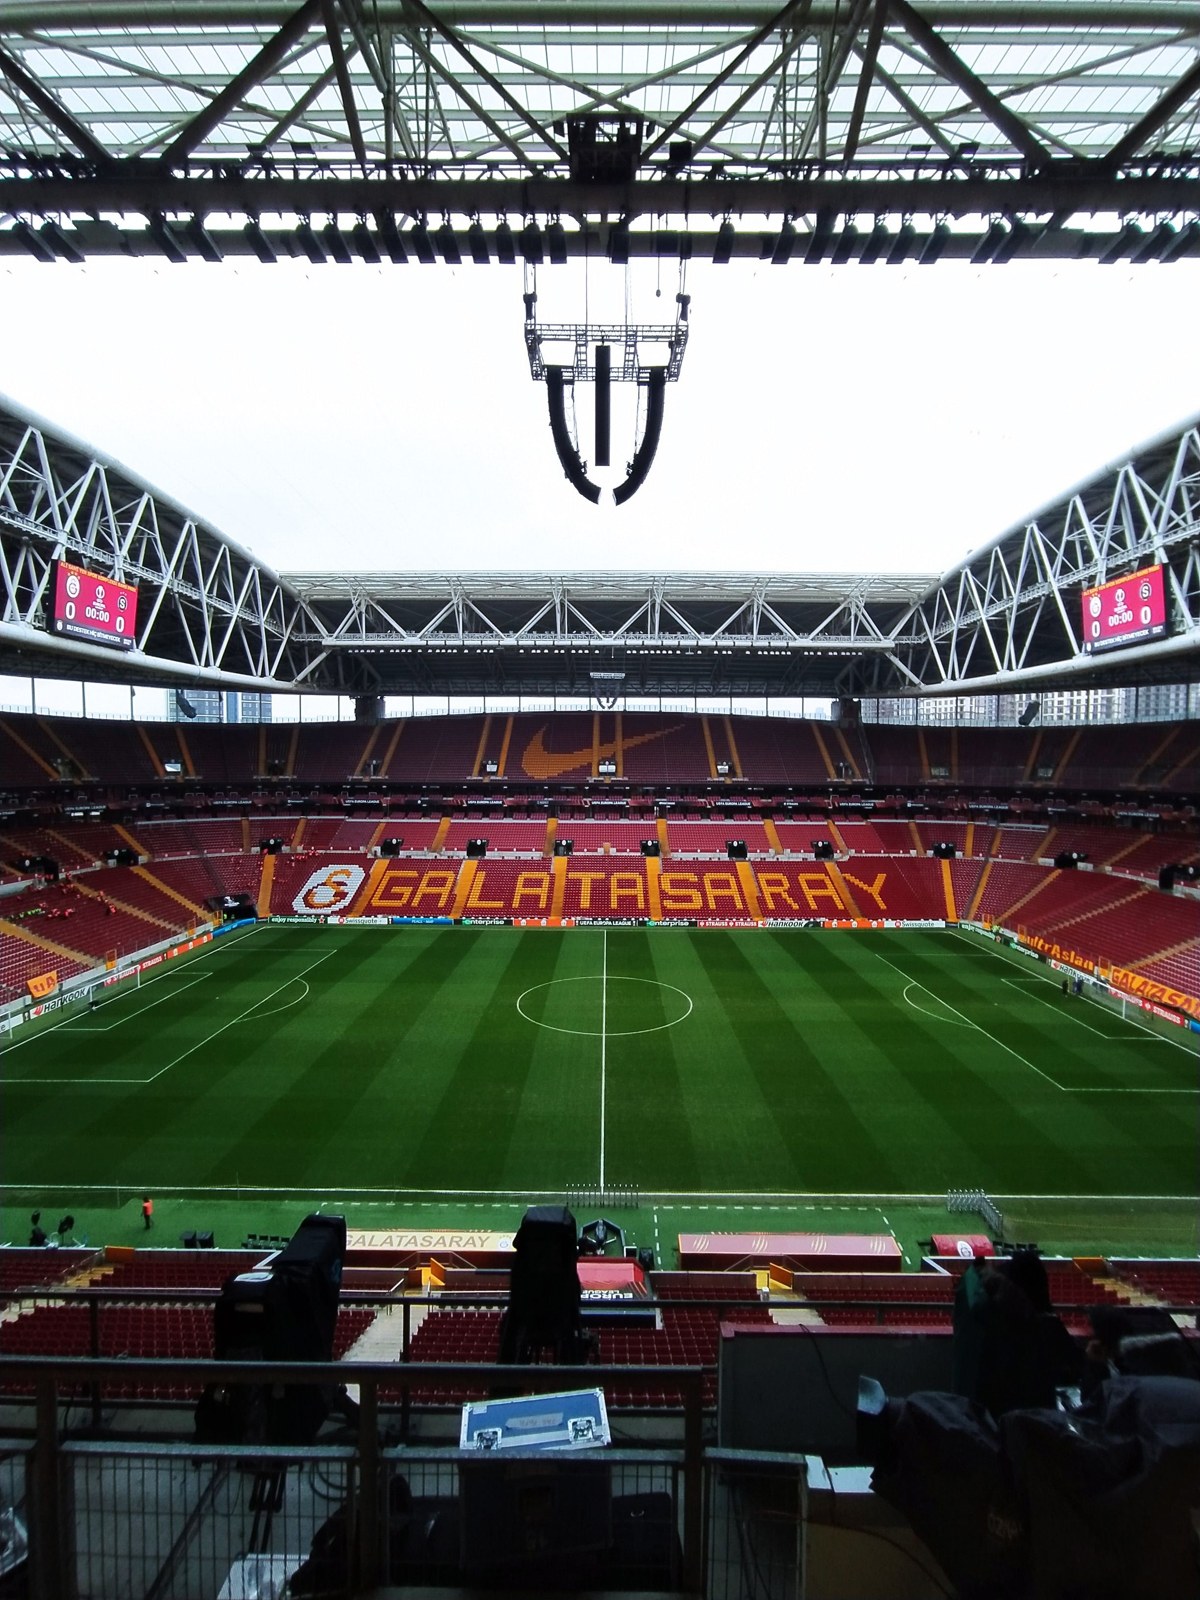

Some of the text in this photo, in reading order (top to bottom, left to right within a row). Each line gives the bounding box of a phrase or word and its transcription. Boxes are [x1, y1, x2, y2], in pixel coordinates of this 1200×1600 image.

[65, 602, 76, 619] 0
[85, 606, 110, 622] 00:00
[1108, 611, 1133, 626] 00:00
[1141, 606, 1151, 624] 0
[116, 616, 125, 633] 0
[1092, 621, 1100, 637] 0
[370, 870, 886, 910] GALATASARAY
